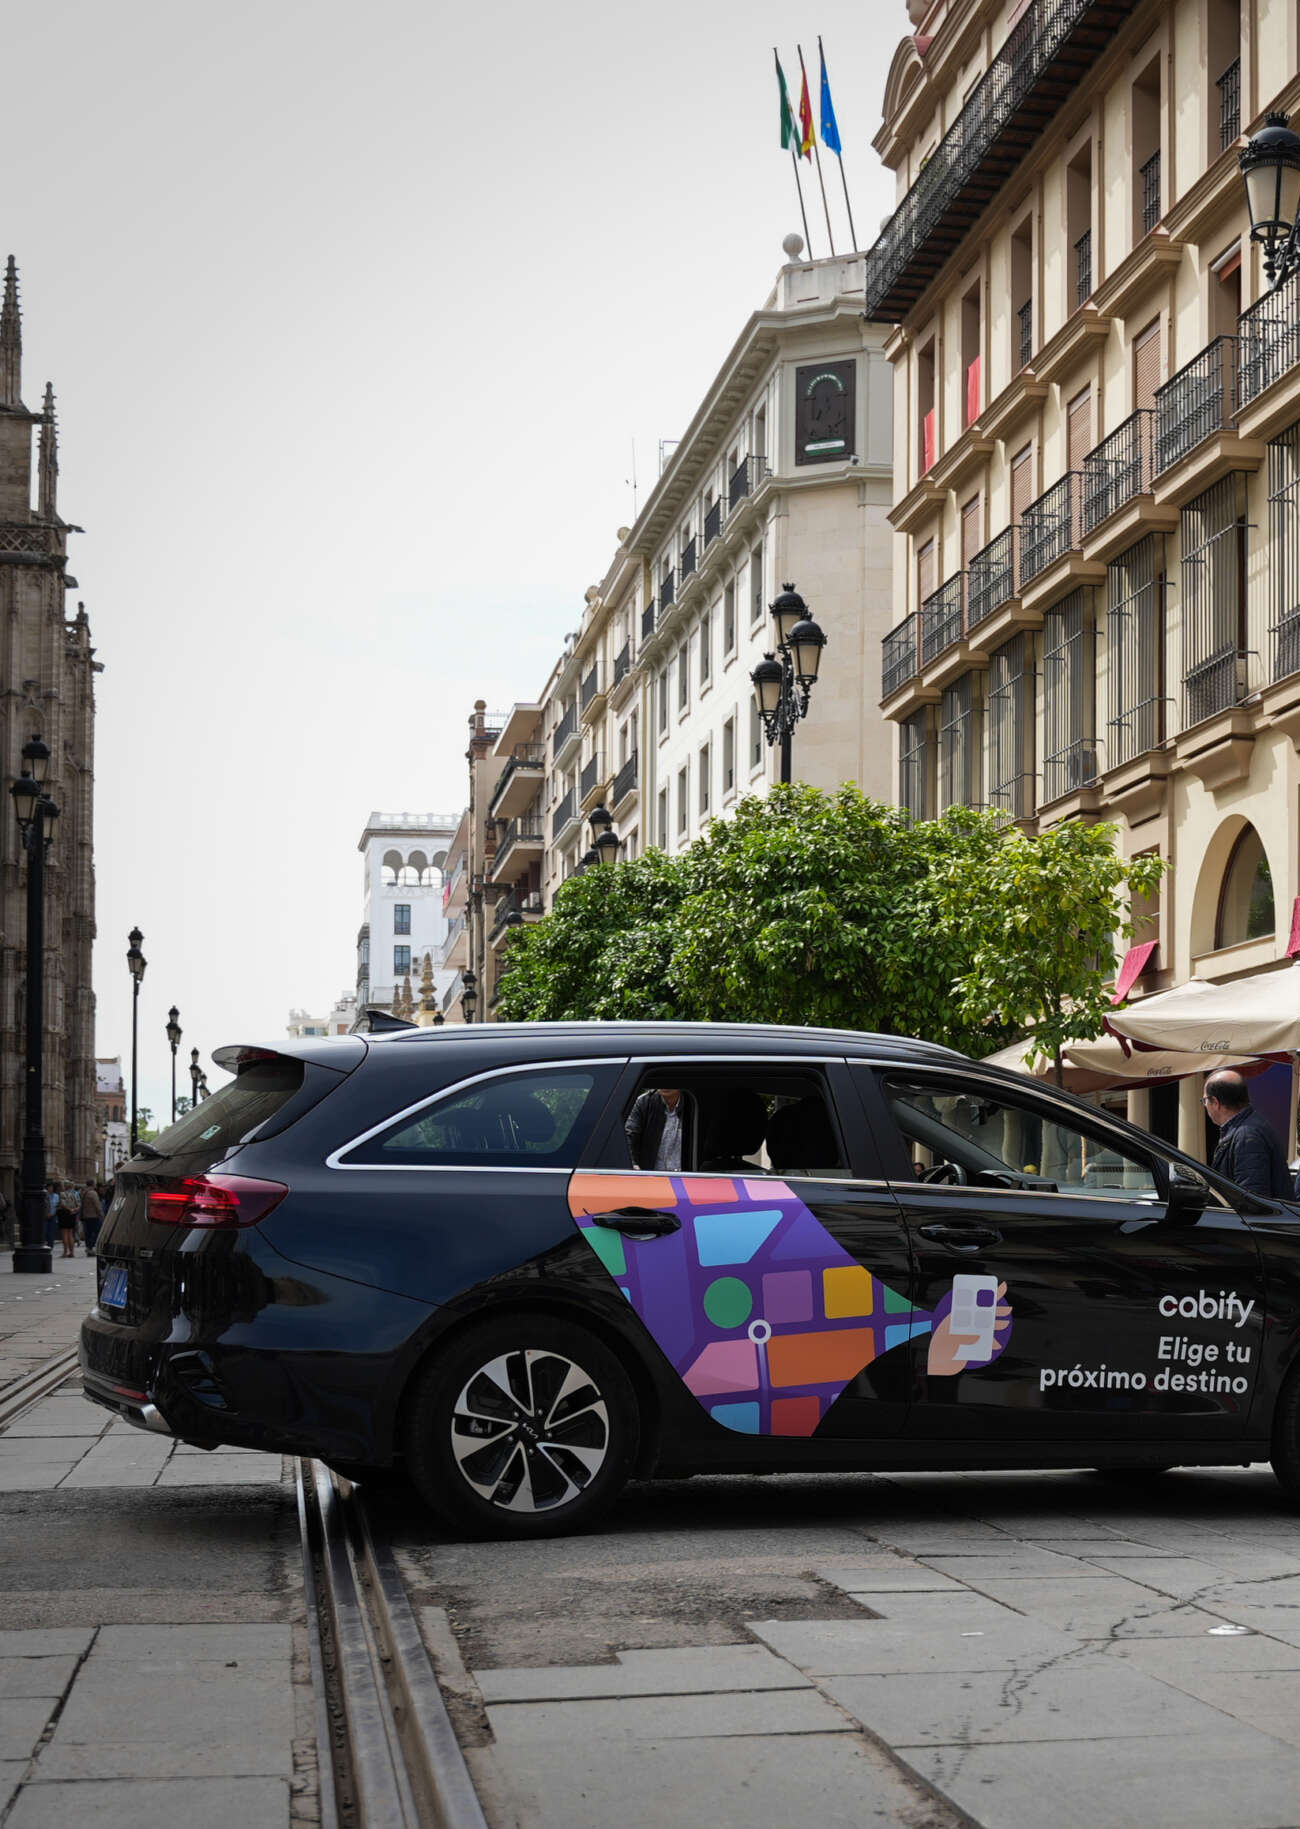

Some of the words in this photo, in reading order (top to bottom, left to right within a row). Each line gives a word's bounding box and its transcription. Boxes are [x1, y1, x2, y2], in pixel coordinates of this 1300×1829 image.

[1158, 1289, 1255, 1328] cabify
[1157, 1336, 1219, 1367] Elige
[1225, 1341, 1251, 1364] tu
[1039, 1364, 1147, 1392] próximo
[1153, 1367, 1248, 1394] destino
